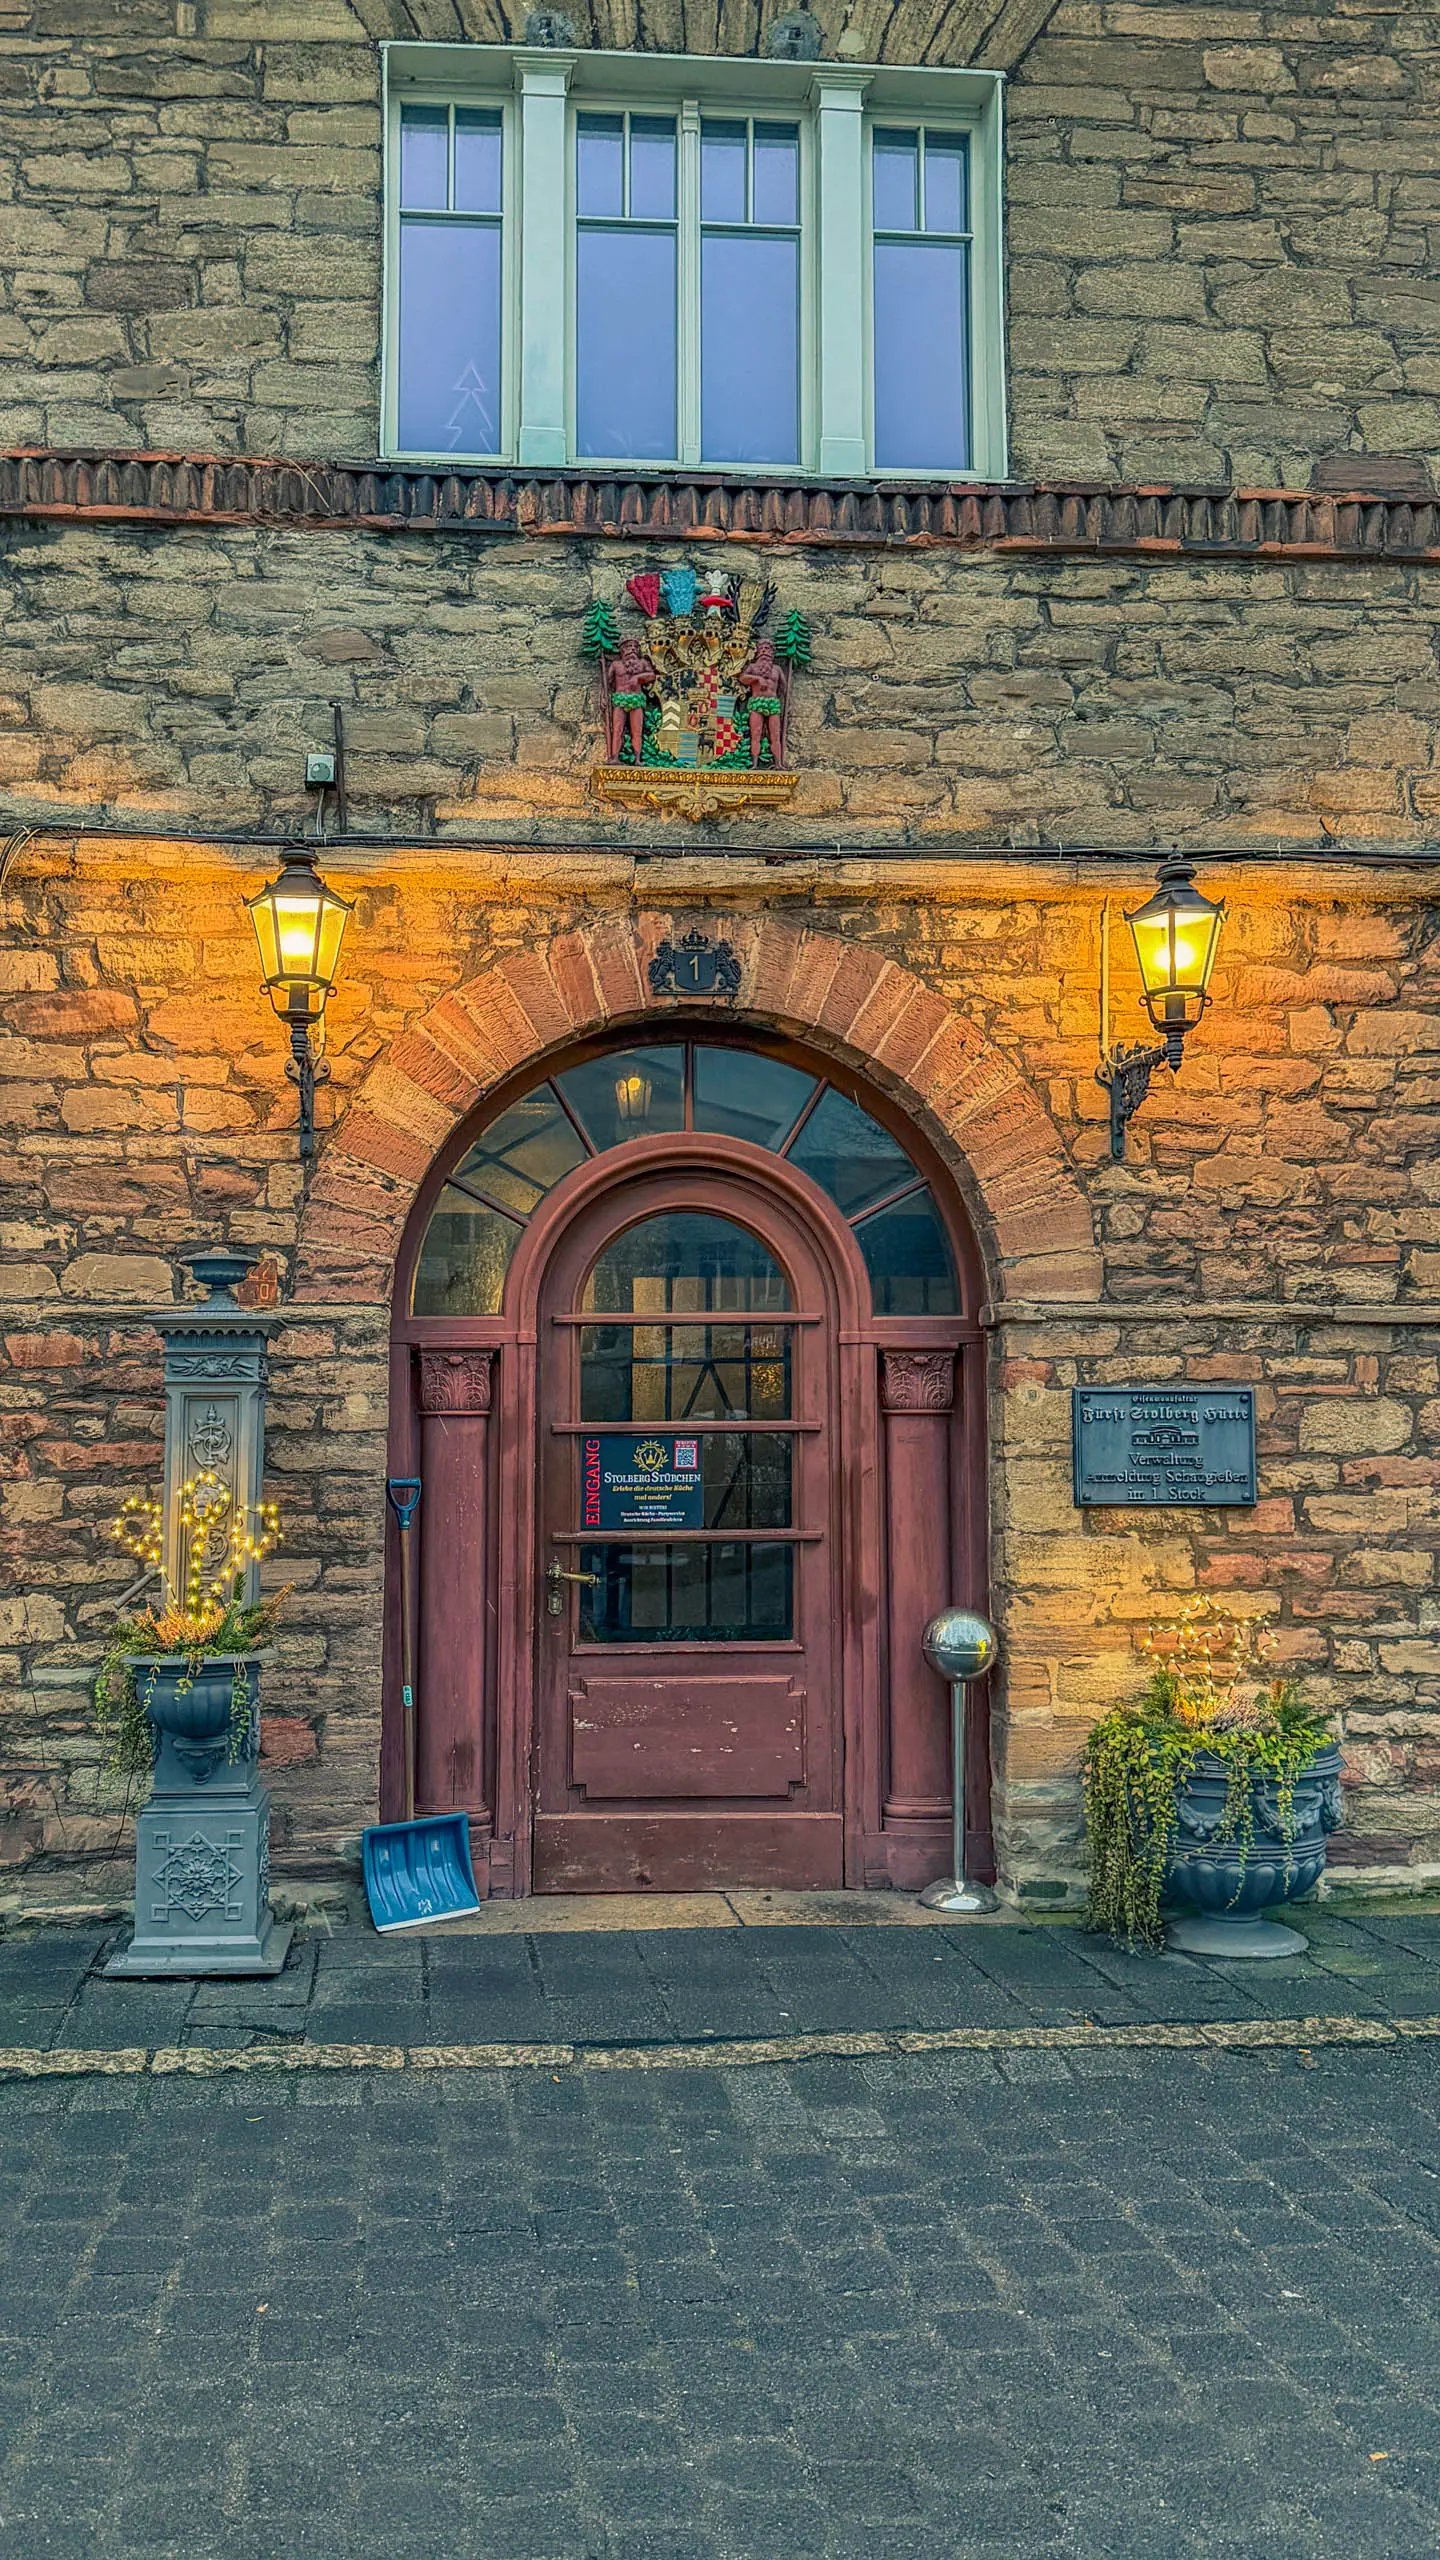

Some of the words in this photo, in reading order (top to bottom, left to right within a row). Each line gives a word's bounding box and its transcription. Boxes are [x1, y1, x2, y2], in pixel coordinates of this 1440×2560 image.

[689, 955, 699, 981] 1
[1130, 1407, 1199, 1423] Stolberg
[1203, 1407, 1248, 1423] Hütte
[1128, 1452, 1204, 1468] Verwaltung
[585, 1439, 601, 1525] EINGANG
[604, 1472, 650, 1483] STOLBERG
[1085, 1470, 1161, 1484] Anmeldung
[1128, 1487, 1145, 1500] im
[1168, 1487, 1206, 1500] Stock
